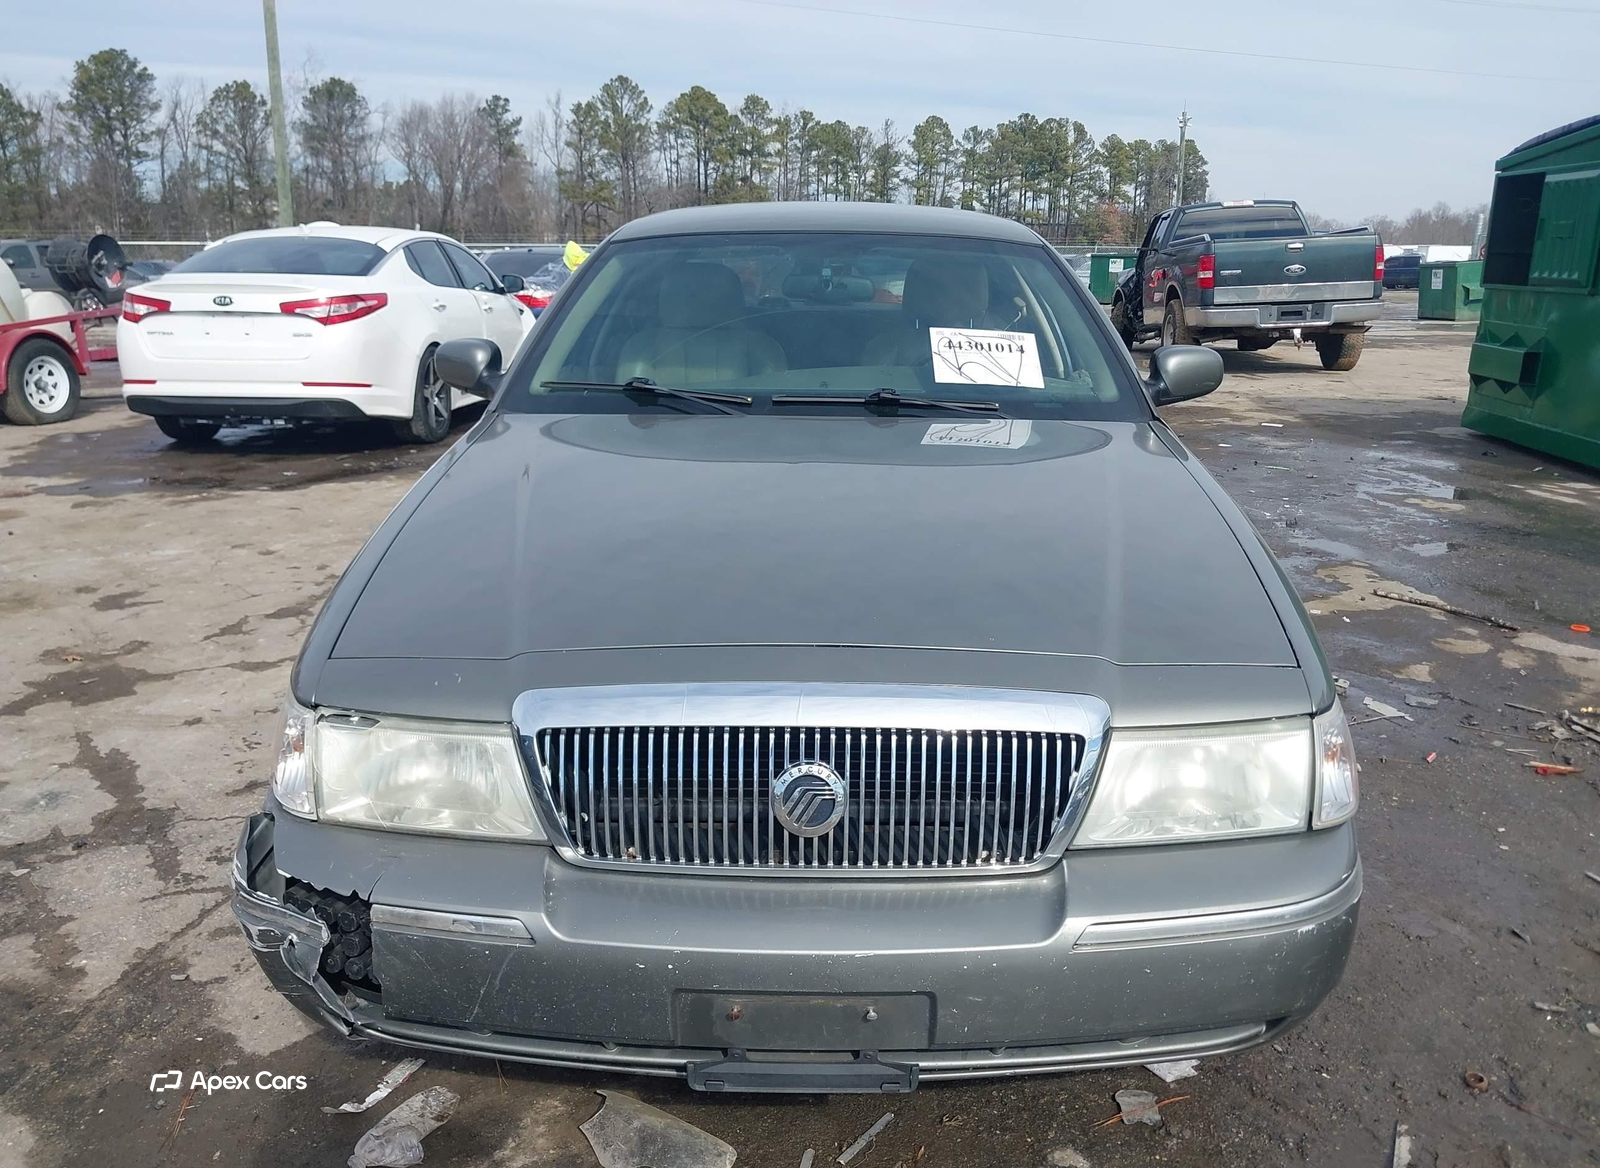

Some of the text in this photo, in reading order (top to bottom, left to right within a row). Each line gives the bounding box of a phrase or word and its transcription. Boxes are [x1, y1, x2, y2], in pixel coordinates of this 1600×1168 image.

[215, 297, 230, 305] KIA
[943, 339, 1026, 355] 44301014
[781, 766, 838, 786] MERCURY
